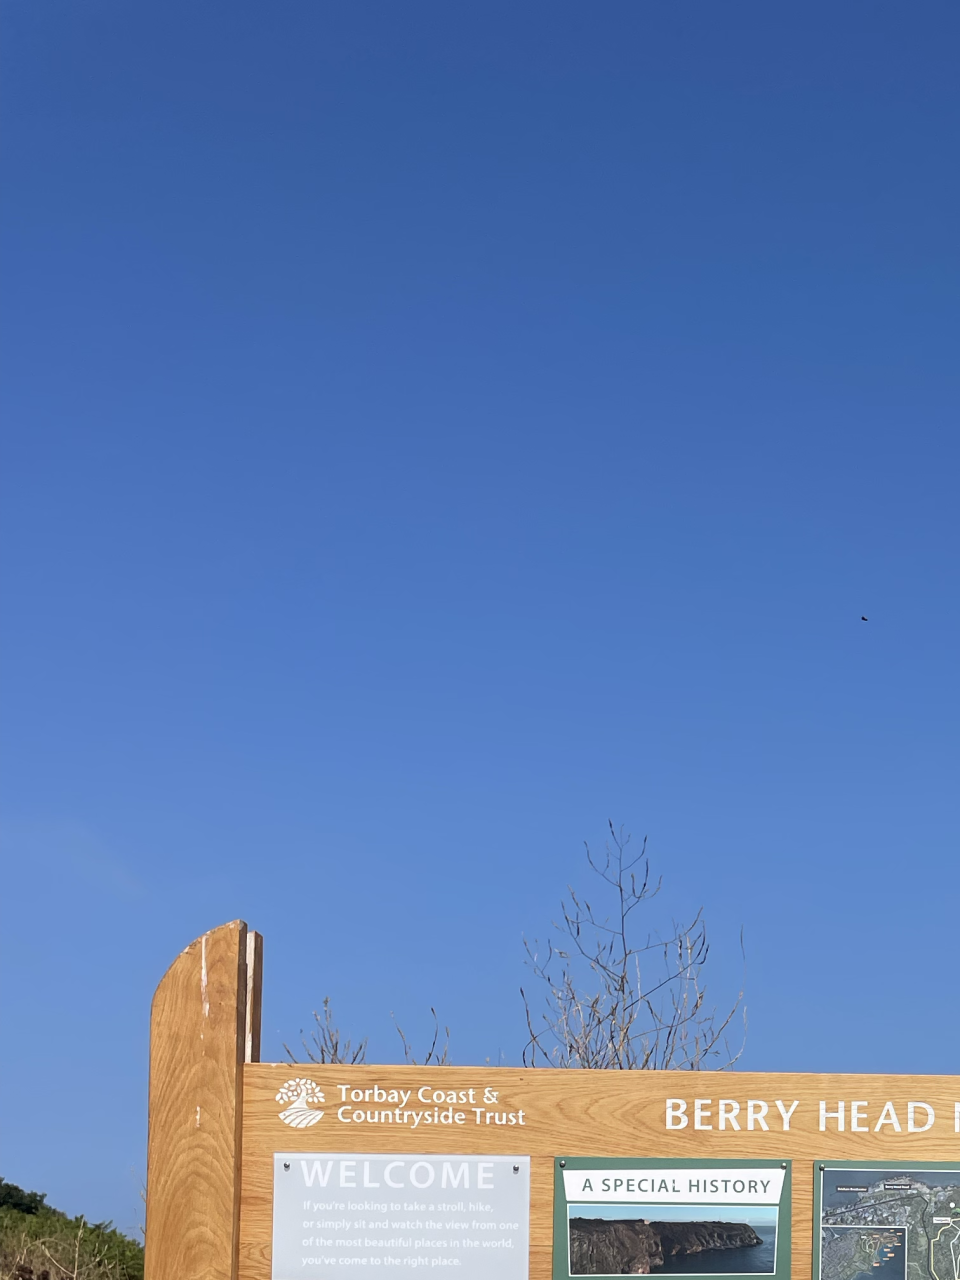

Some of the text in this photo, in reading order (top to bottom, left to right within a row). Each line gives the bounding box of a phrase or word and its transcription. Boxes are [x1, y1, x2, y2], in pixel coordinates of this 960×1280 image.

[337, 1085, 499, 1107] Torbay Coast &
[337, 1105, 526, 1129] Countryside Trust
[666, 1098, 800, 1131] BERRY
[819, 1100, 935, 1133] HEAD
[300, 1160, 495, 1189] WELCOME
[582, 1178, 771, 1194] A SPECIAL HISTORY
[303, 1200, 311, 1210] If
[348, 1200, 388, 1213] looking
[390, 1202, 401, 1211] to
[403, 1201, 426, 1211] take
[316, 1218, 352, 1231] simply
[354, 1219, 366, 1229] sit
[368, 1219, 389, 1229] and
[391, 1219, 423, 1229] watch
[425, 1219, 443, 1230] the
[445, 1220, 470, 1230] view
[472, 1220, 497, 1230] from
[302, 1236, 314, 1246] of
[315, 1236, 333, 1247] the
[335, 1238, 362, 1247] most
[364, 1237, 412, 1247] beautiful
[414, 1238, 448, 1249] places
[450, 1239, 460, 1248] in
[462, 1238, 480, 1248] the
[370, 1256, 381, 1265] to
[384, 1255, 401, 1265] the
[403, 1255, 429, 1268] right
